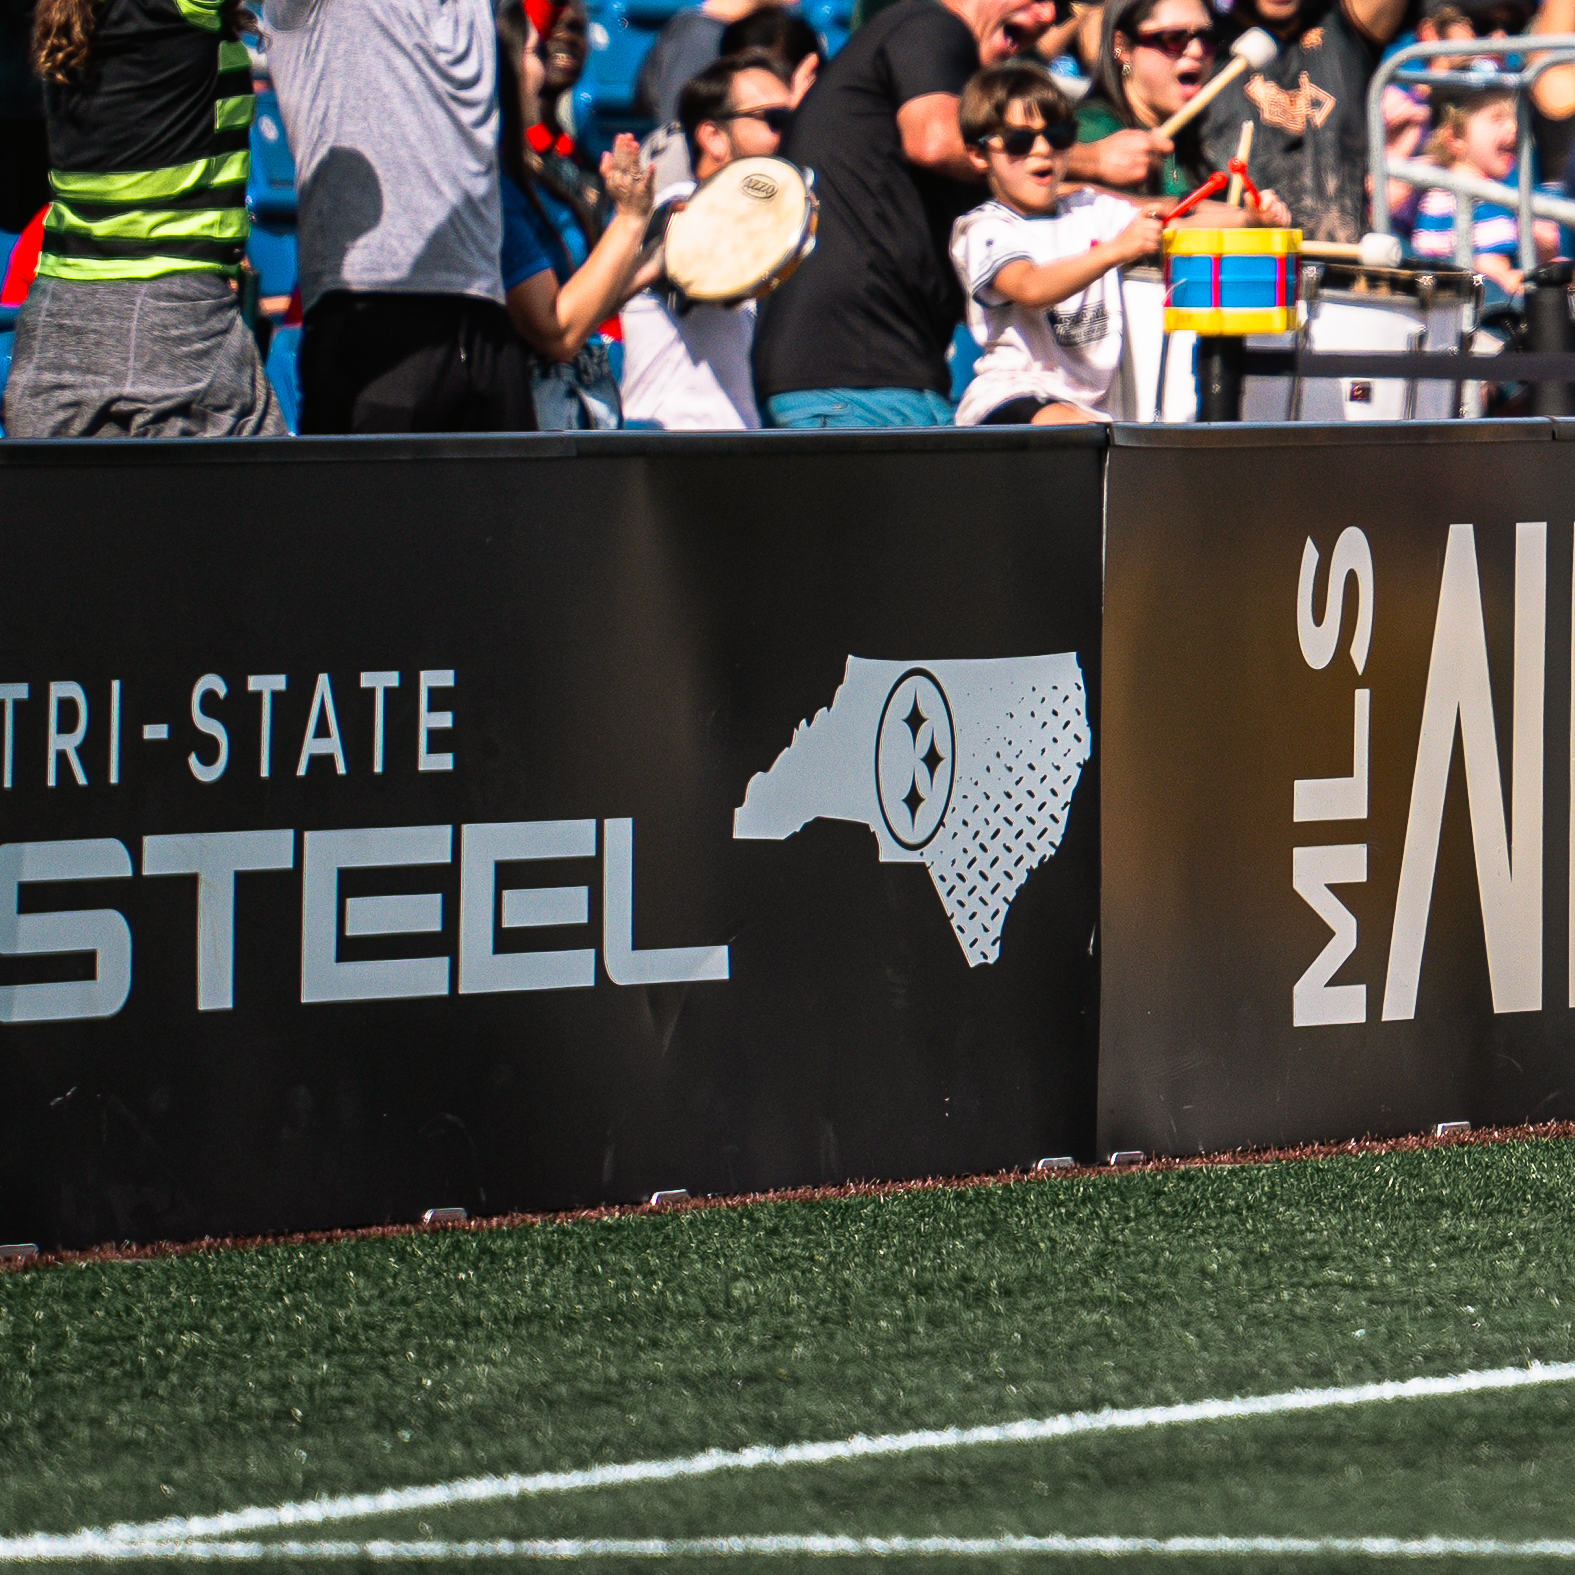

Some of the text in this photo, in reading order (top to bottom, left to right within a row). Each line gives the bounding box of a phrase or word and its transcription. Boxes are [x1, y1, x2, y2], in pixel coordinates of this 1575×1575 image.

[0, 669, 456, 789] TRI-STATE
[1292, 525, 1375, 1028] MLS
[0, 816, 731, 1023] STEEL
